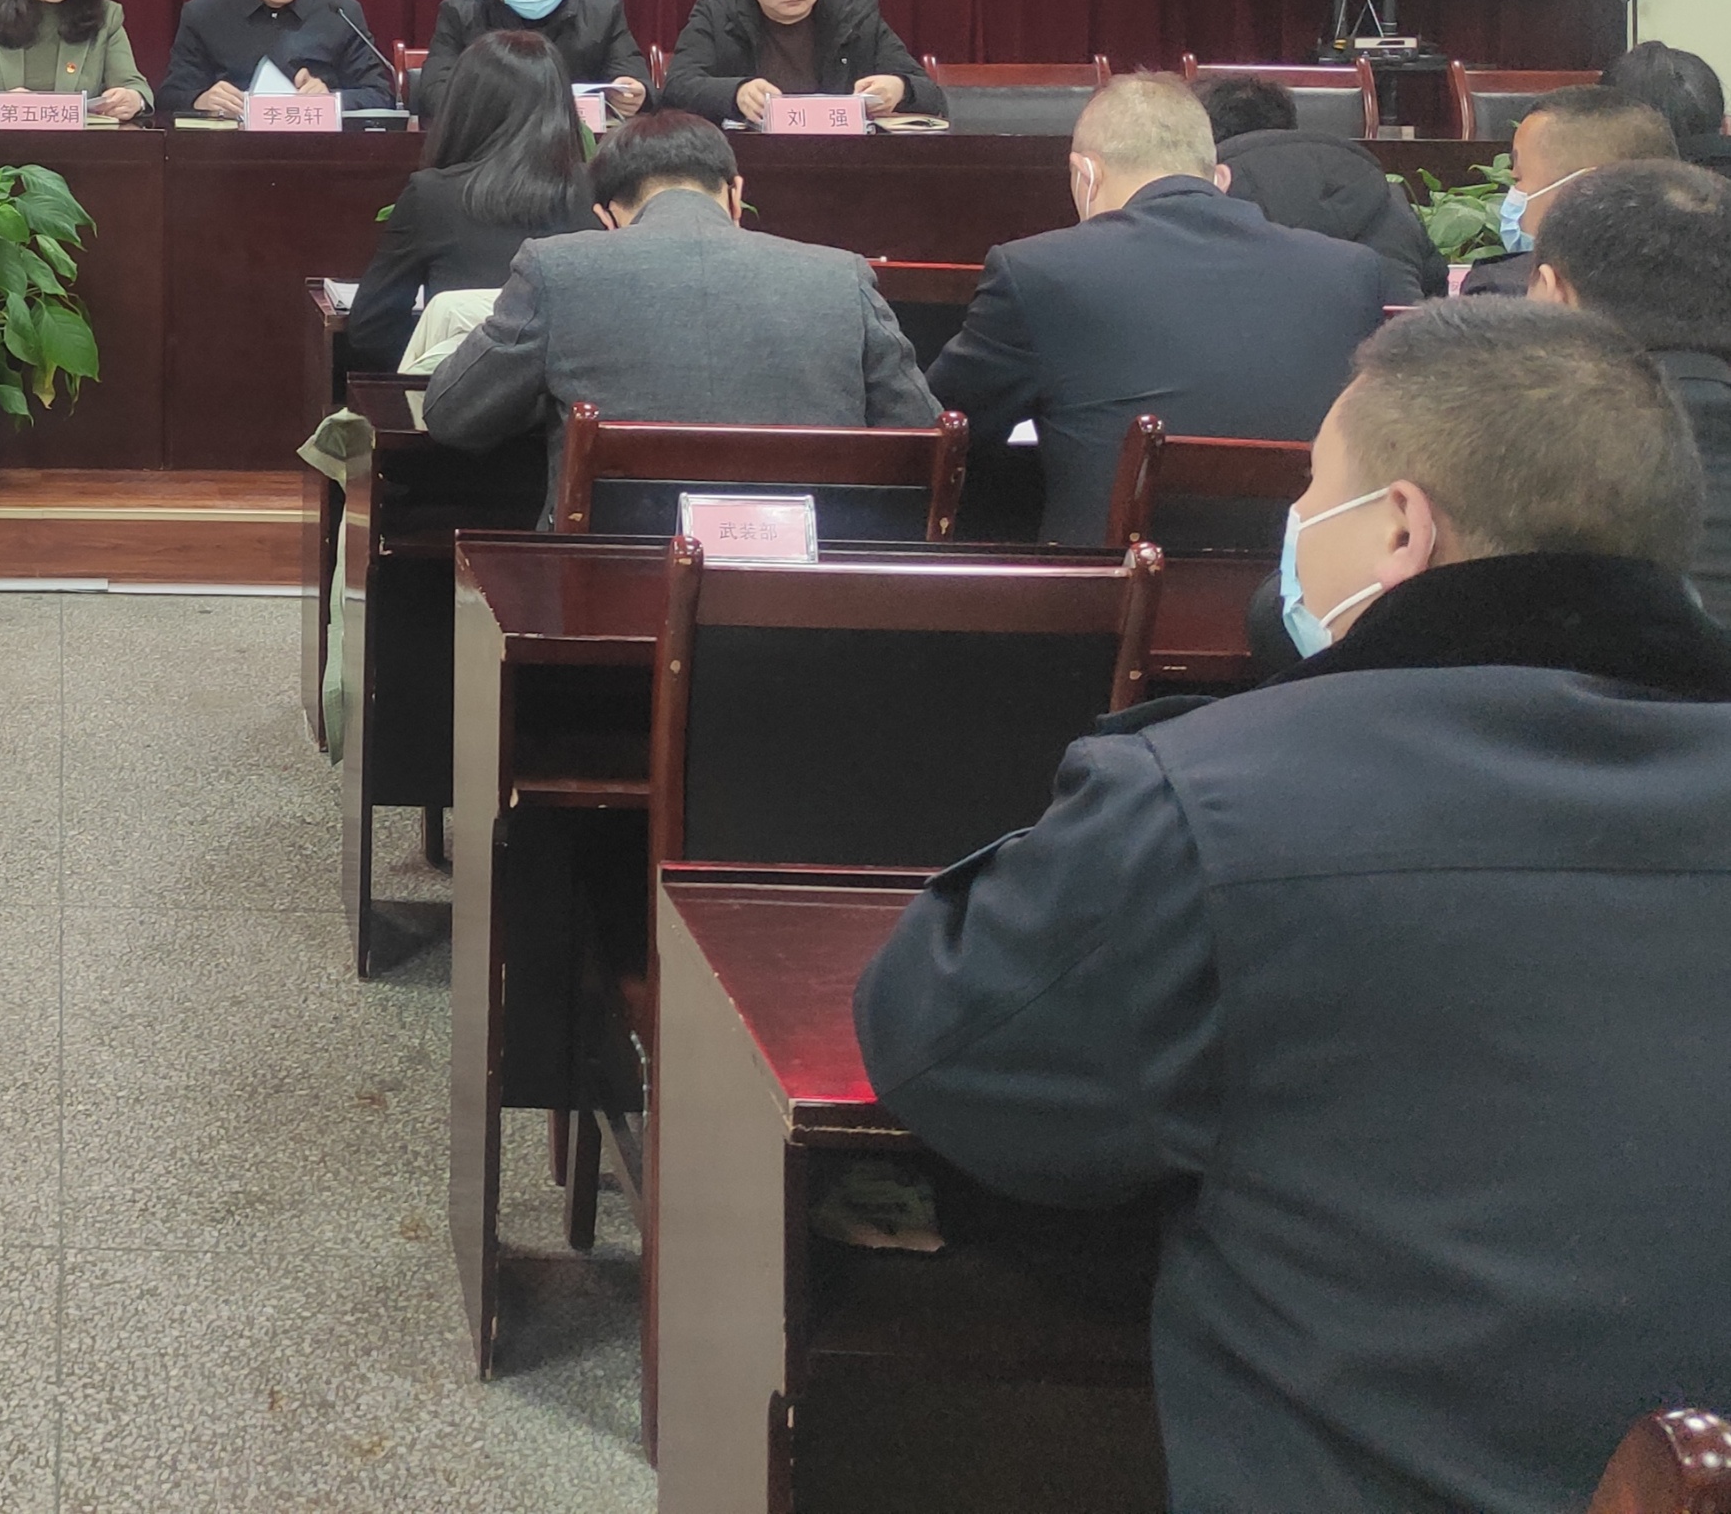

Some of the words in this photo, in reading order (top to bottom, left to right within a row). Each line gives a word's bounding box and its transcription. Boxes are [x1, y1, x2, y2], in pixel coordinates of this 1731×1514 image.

[0, 105, 80, 124] 第五晓娟
[263, 107, 323, 125] 李易轩
[719, 522, 778, 541] 武装部
